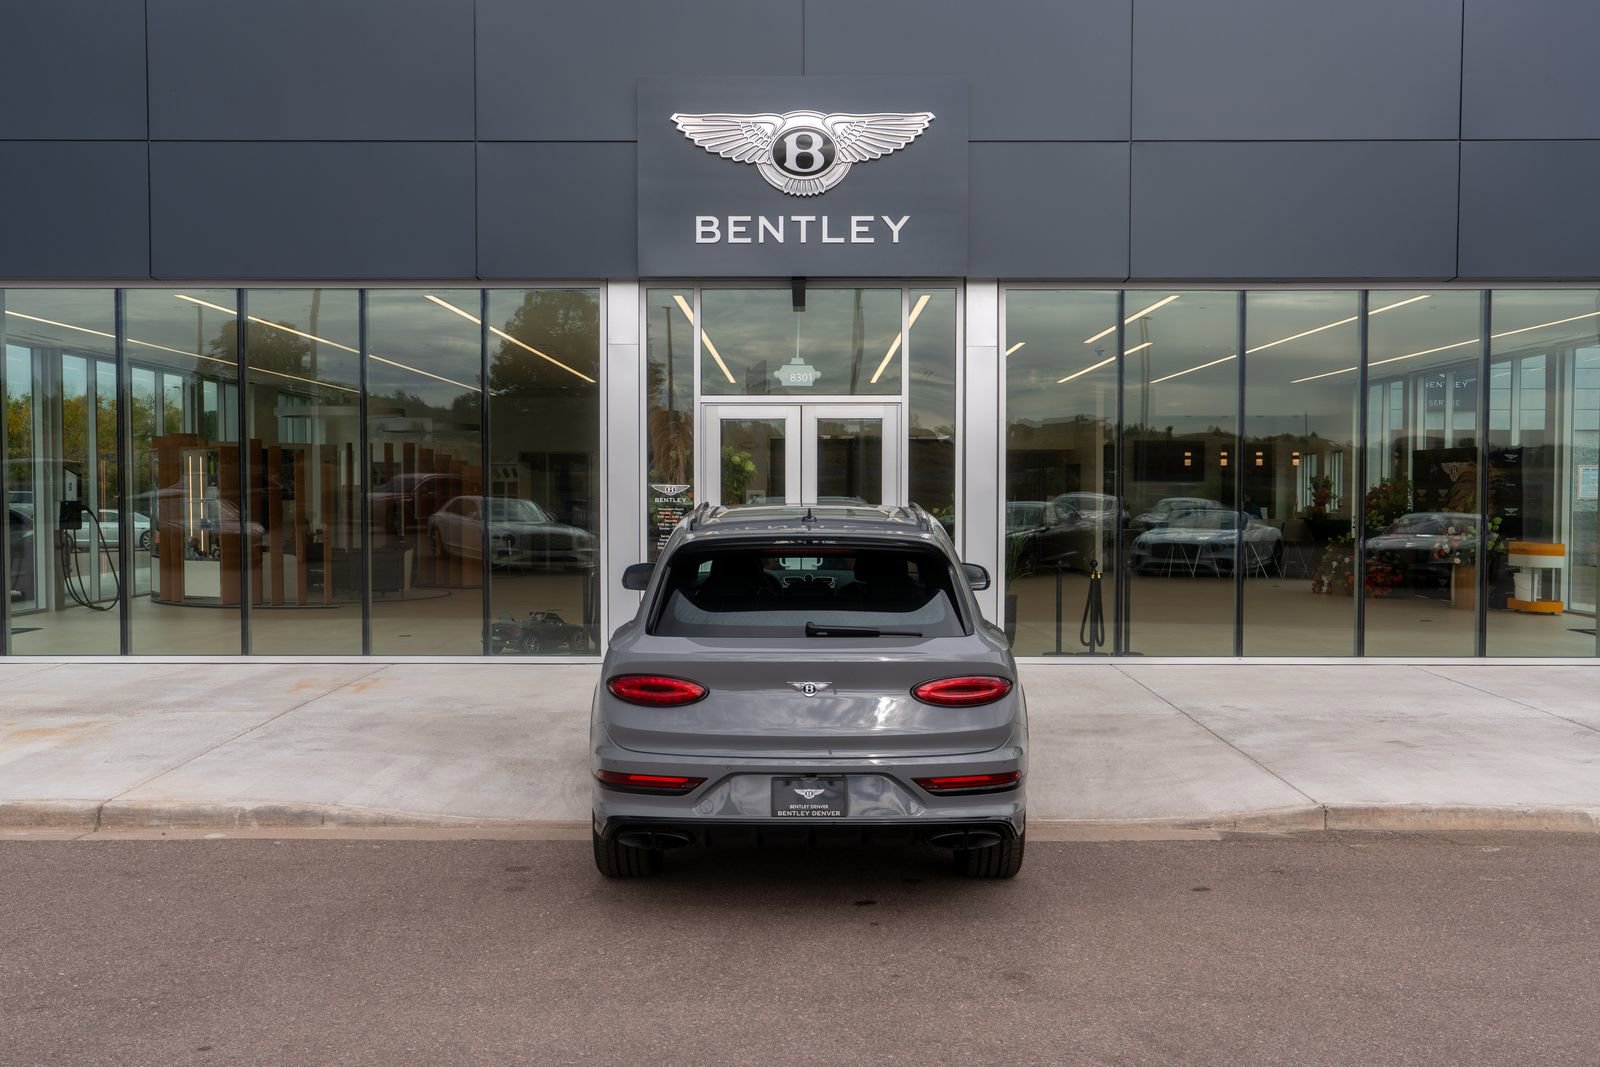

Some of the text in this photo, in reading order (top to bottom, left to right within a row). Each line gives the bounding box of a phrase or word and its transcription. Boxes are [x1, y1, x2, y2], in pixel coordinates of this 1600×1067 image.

[784, 131, 825, 173] B
[695, 215, 910, 244] BENTLEY
[789, 373, 813, 383] 8301
[805, 684, 814, 693] B
